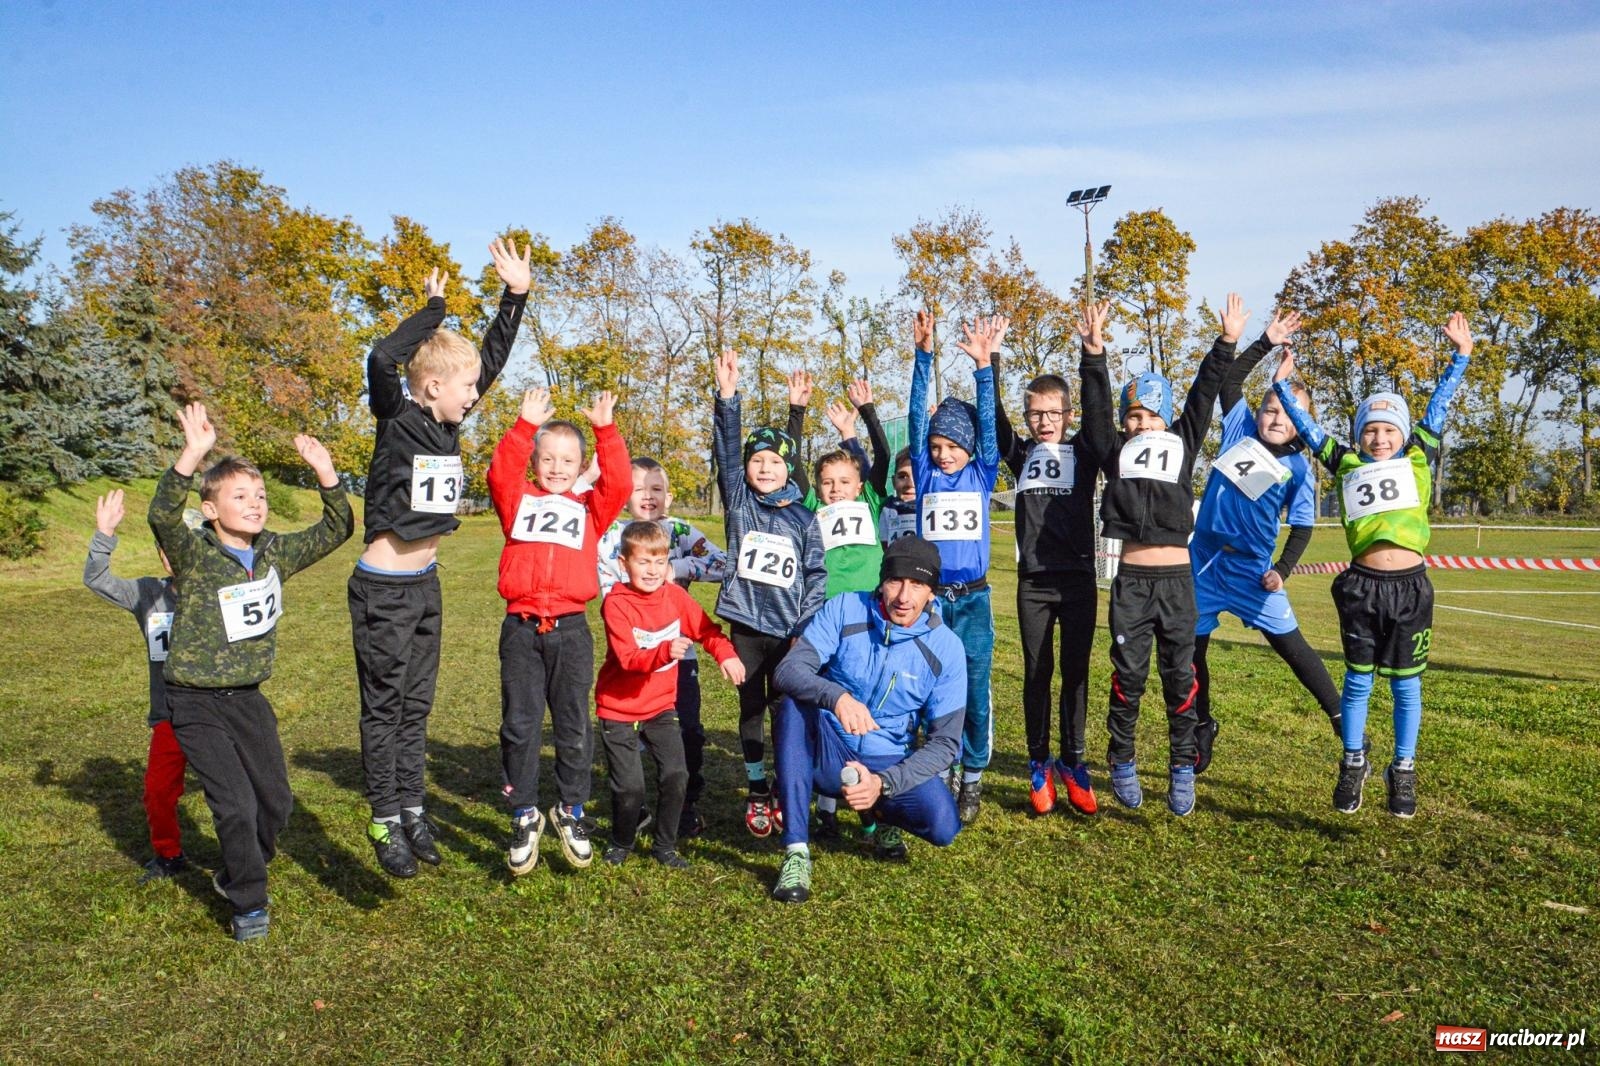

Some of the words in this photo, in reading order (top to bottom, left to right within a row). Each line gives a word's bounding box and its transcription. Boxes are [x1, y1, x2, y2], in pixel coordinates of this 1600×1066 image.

[1026, 458, 1061, 480] 58
[1134, 447, 1169, 472] 41
[1234, 460, 1256, 477] 4
[419, 476, 462, 502] 13
[1356, 478, 1400, 507] 38
[522, 511, 580, 539] 124
[831, 516, 864, 537] 47
[925, 509, 979, 532] 133
[744, 548, 795, 579] 126
[242, 592, 277, 626] 52
[1411, 628, 1432, 656] 23
